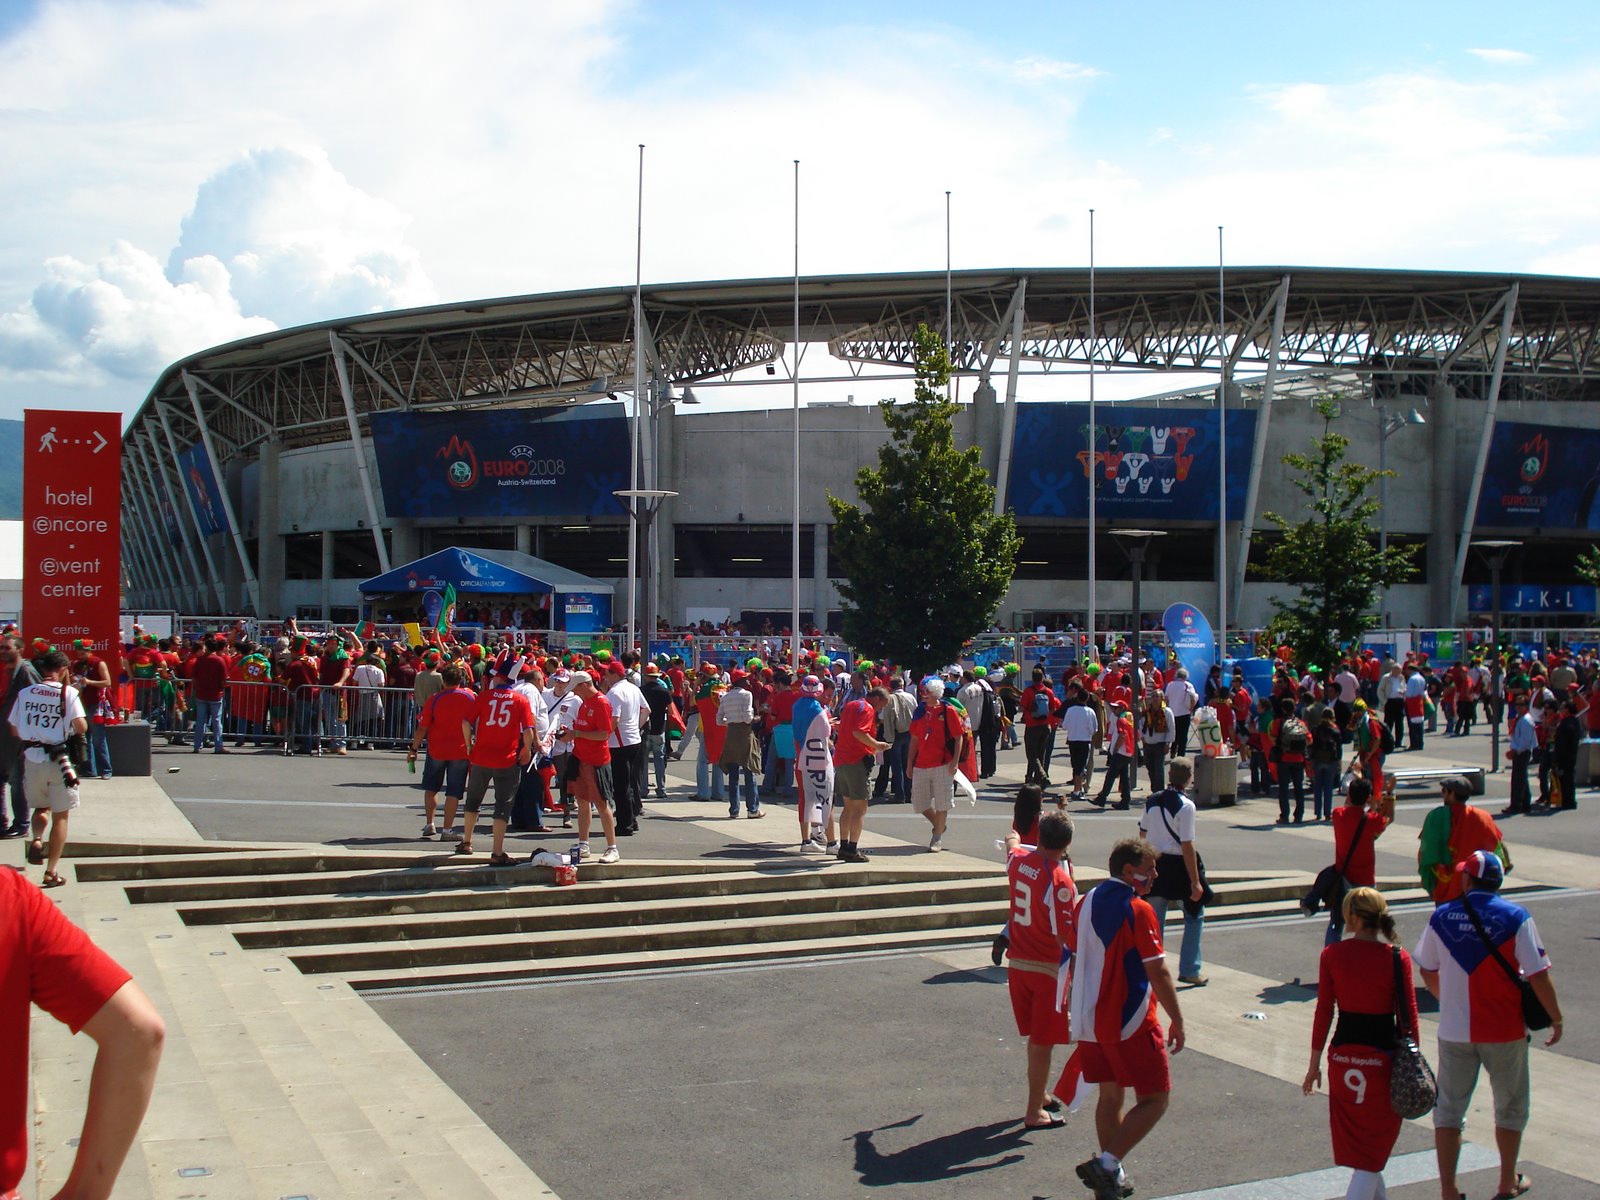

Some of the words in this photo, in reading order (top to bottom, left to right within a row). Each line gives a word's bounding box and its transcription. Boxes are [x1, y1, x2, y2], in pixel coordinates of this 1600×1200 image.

[510, 445, 535, 458] UEFA
[482, 459, 566, 478] EURO2008
[497, 478, 557, 487] Austria-Switzerland
[45, 485, 93, 506] hotel
[41, 582, 102, 597] center
[52, 625, 91, 635] centre
[516, 632, 523, 645] 8
[485, 699, 514, 728] 15
[1013, 880, 1032, 927] 3
[1447, 911, 1470, 921] CZECH
[1343, 1068, 1367, 1105] 9
